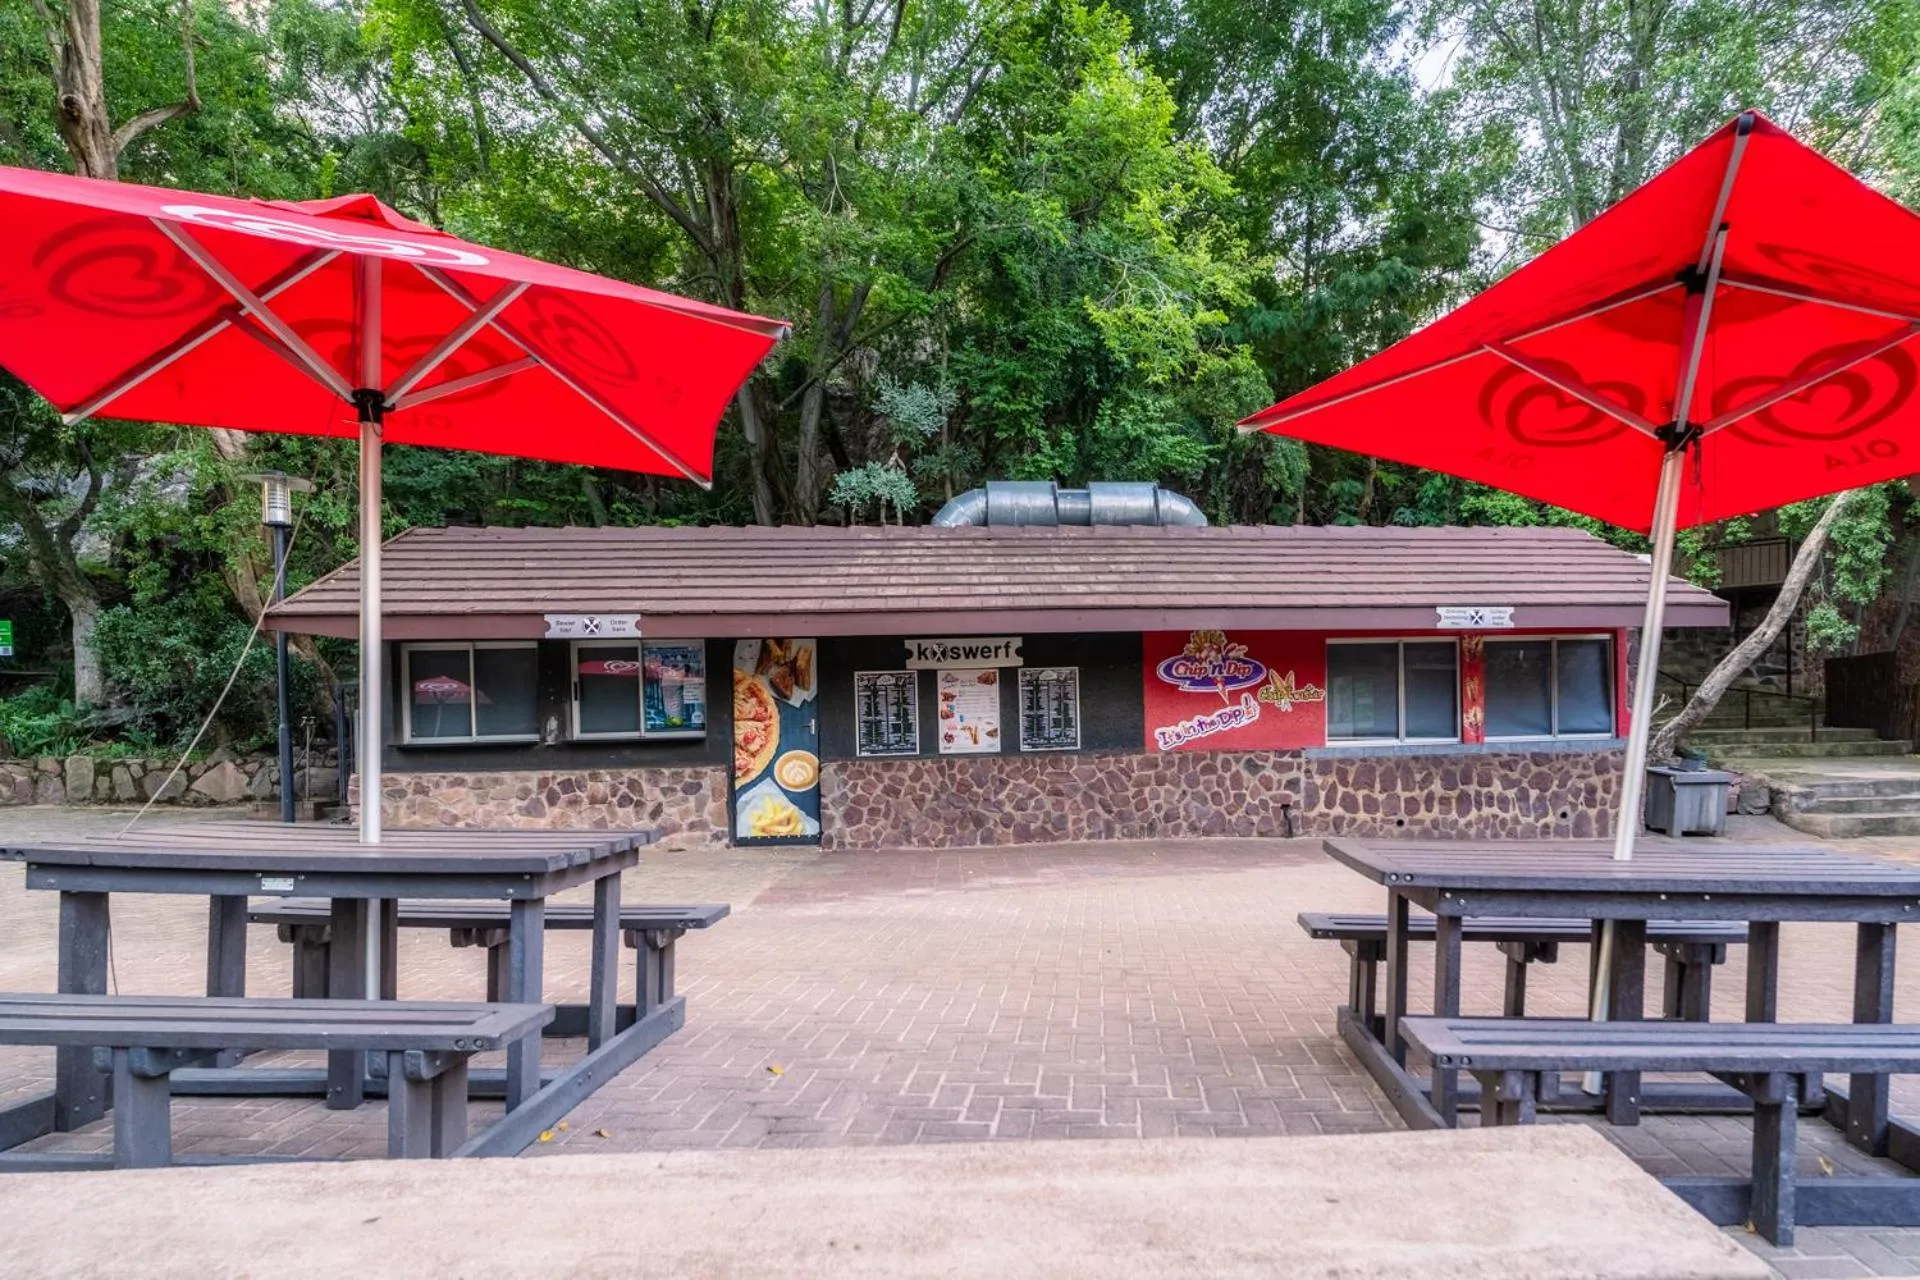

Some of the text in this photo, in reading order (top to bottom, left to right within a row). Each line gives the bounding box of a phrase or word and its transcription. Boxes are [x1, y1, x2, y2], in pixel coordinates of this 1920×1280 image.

[1175, 662, 1206, 677] Chip
[1226, 661, 1252, 677] Dip
[1159, 728, 1182, 746] It's
[1182, 724, 1197, 737] in
[1197, 718, 1217, 731] the
